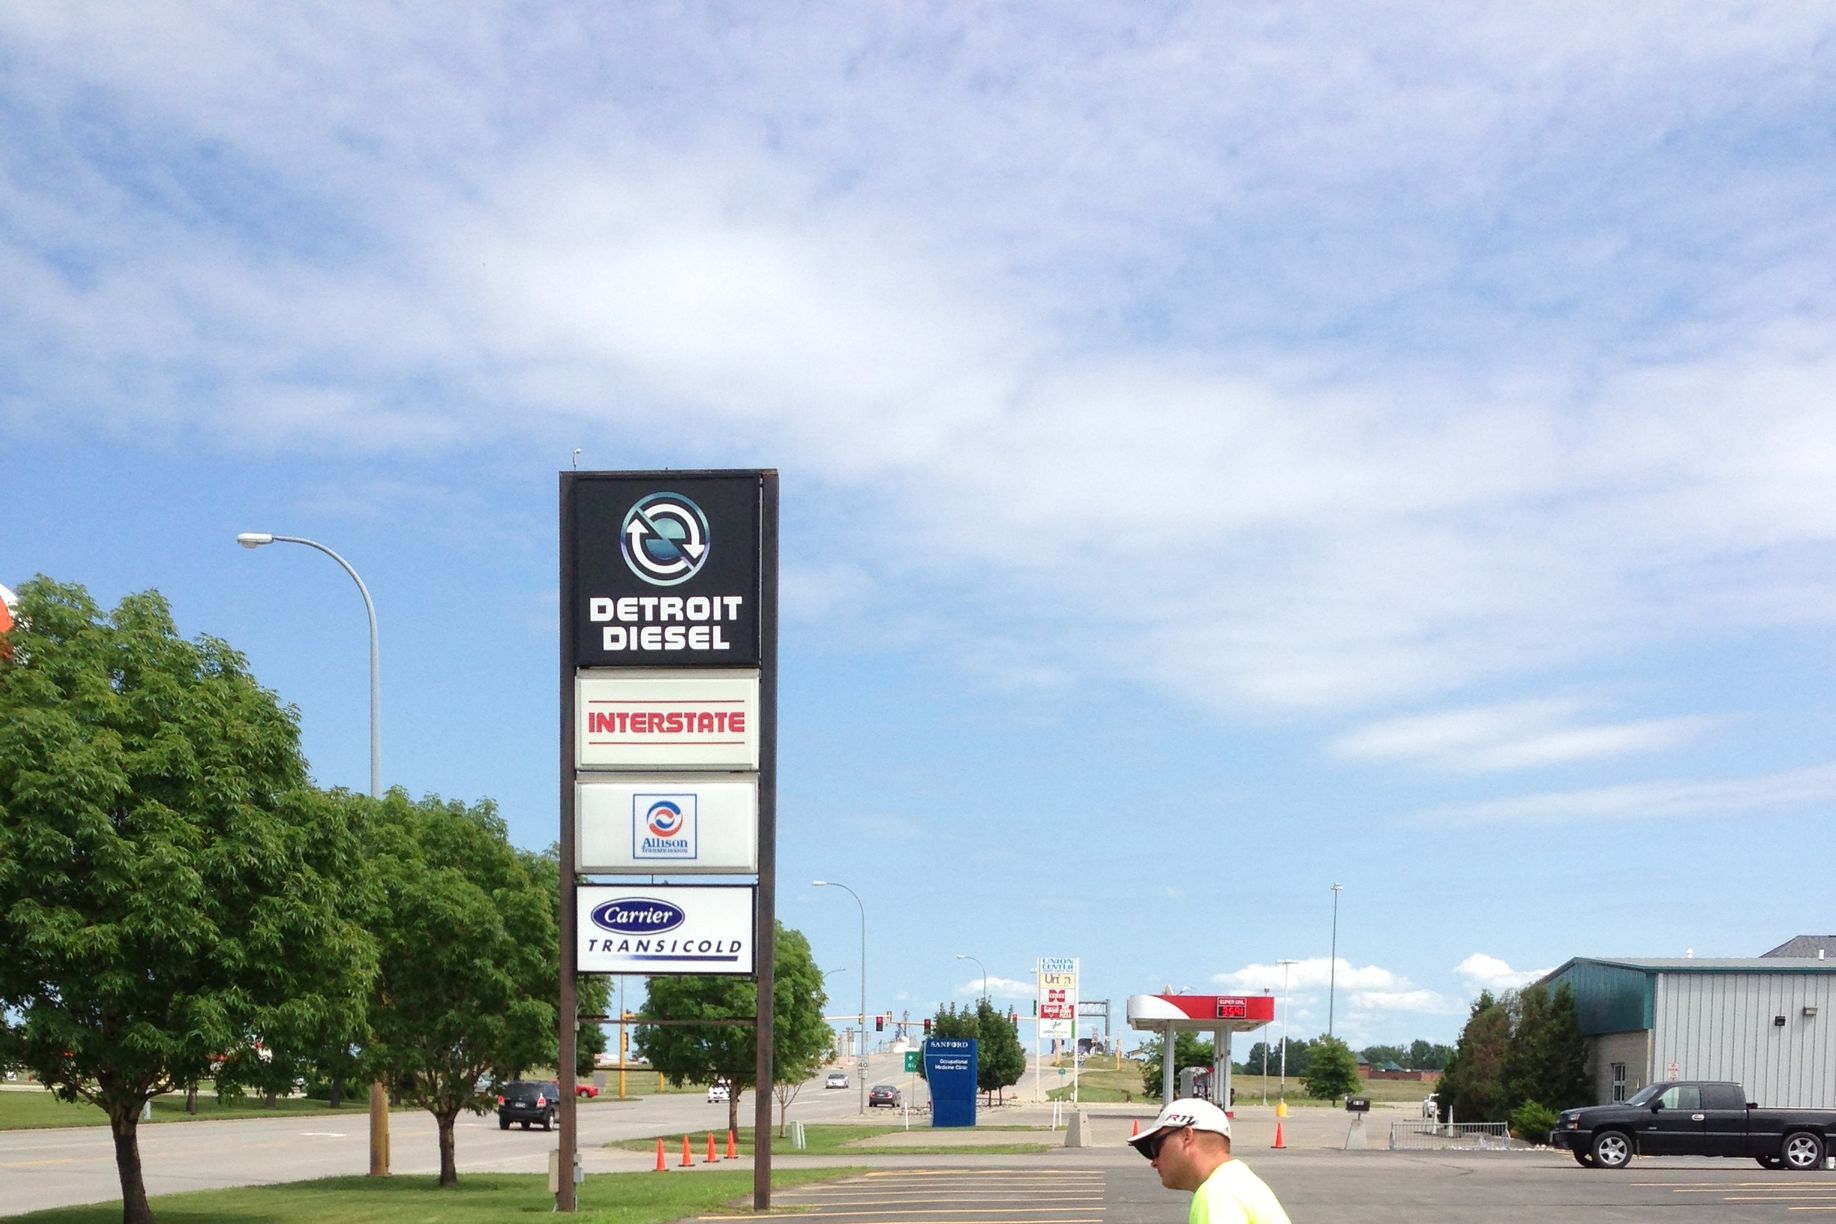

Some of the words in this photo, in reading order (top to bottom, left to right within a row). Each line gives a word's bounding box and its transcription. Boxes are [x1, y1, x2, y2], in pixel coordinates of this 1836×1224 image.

[590, 596, 743, 622] DETROIT
[603, 625, 730, 651] DIESEL
[588, 712, 745, 733] INTERSTATE
[642, 837, 688, 849] Allison
[604, 906, 673, 924] Carrier
[588, 939, 742, 954] TRANSICOLD
